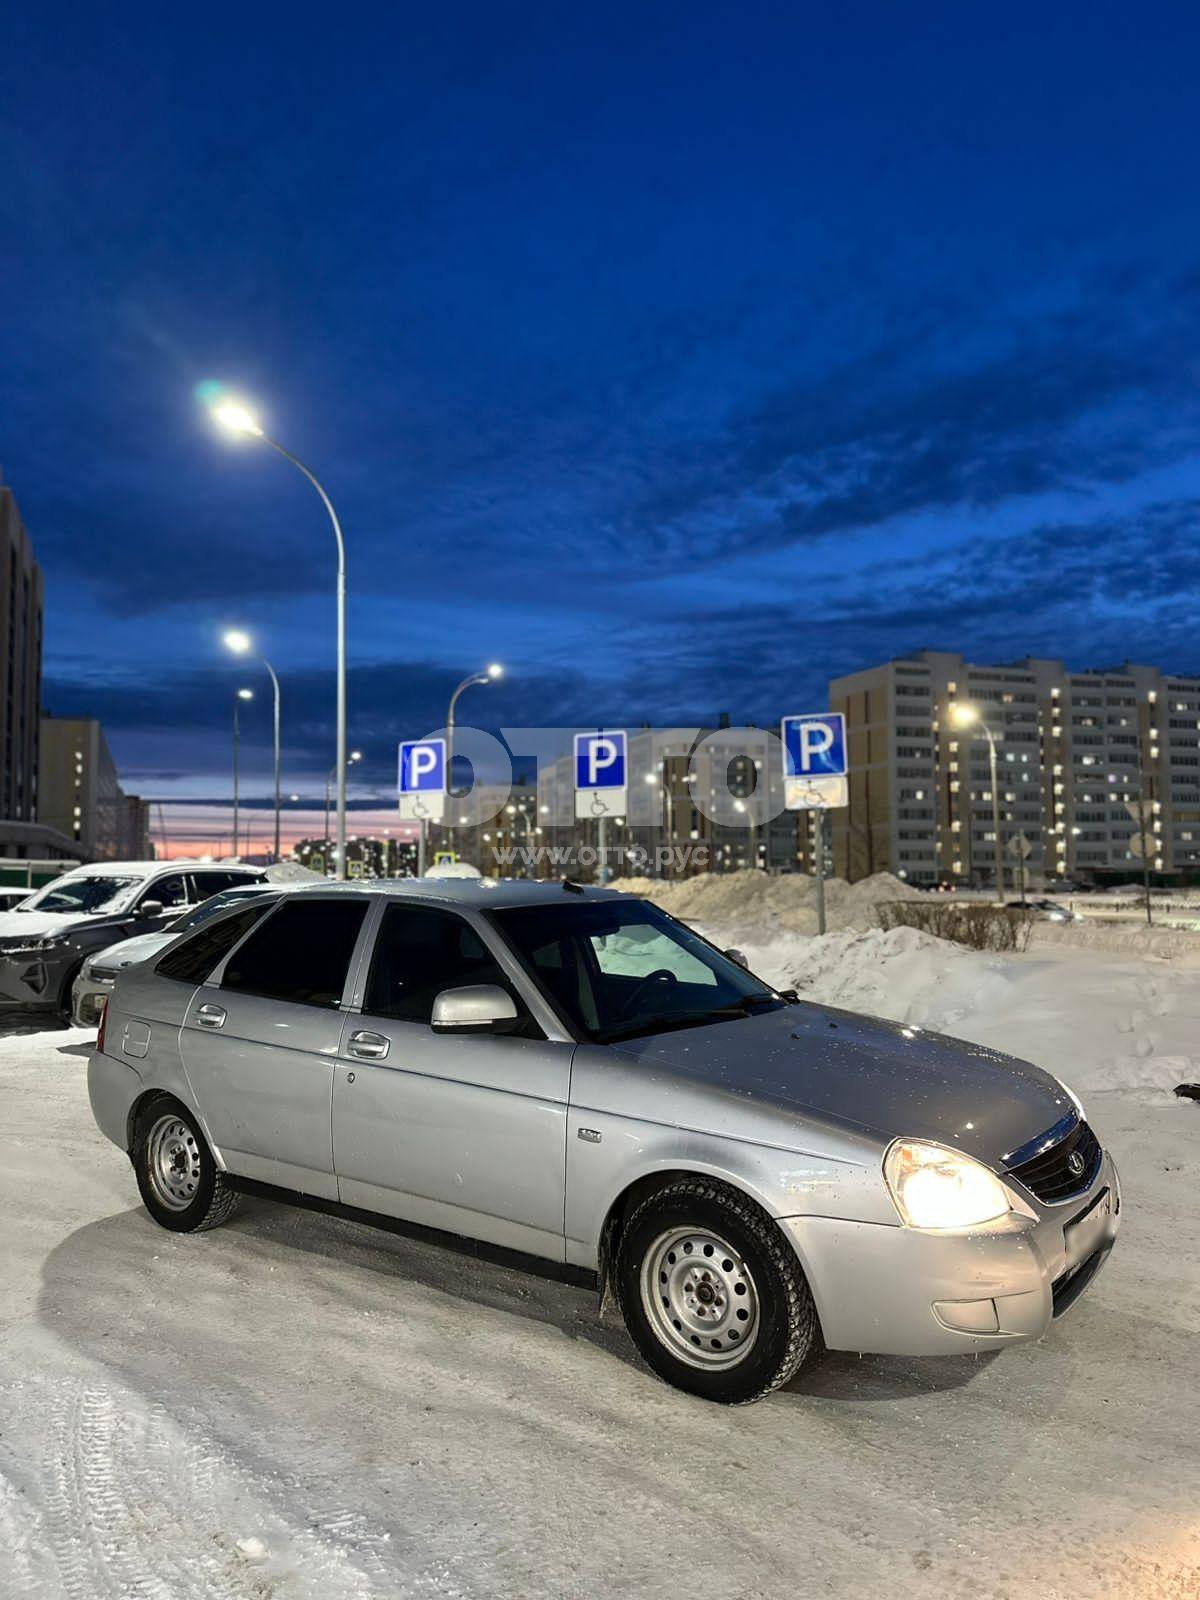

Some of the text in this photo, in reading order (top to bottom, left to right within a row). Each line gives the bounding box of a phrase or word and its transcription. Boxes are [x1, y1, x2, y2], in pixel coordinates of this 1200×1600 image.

[410, 745, 438, 788] P
[588, 738, 617, 785] P
[800, 722, 834, 771] P
